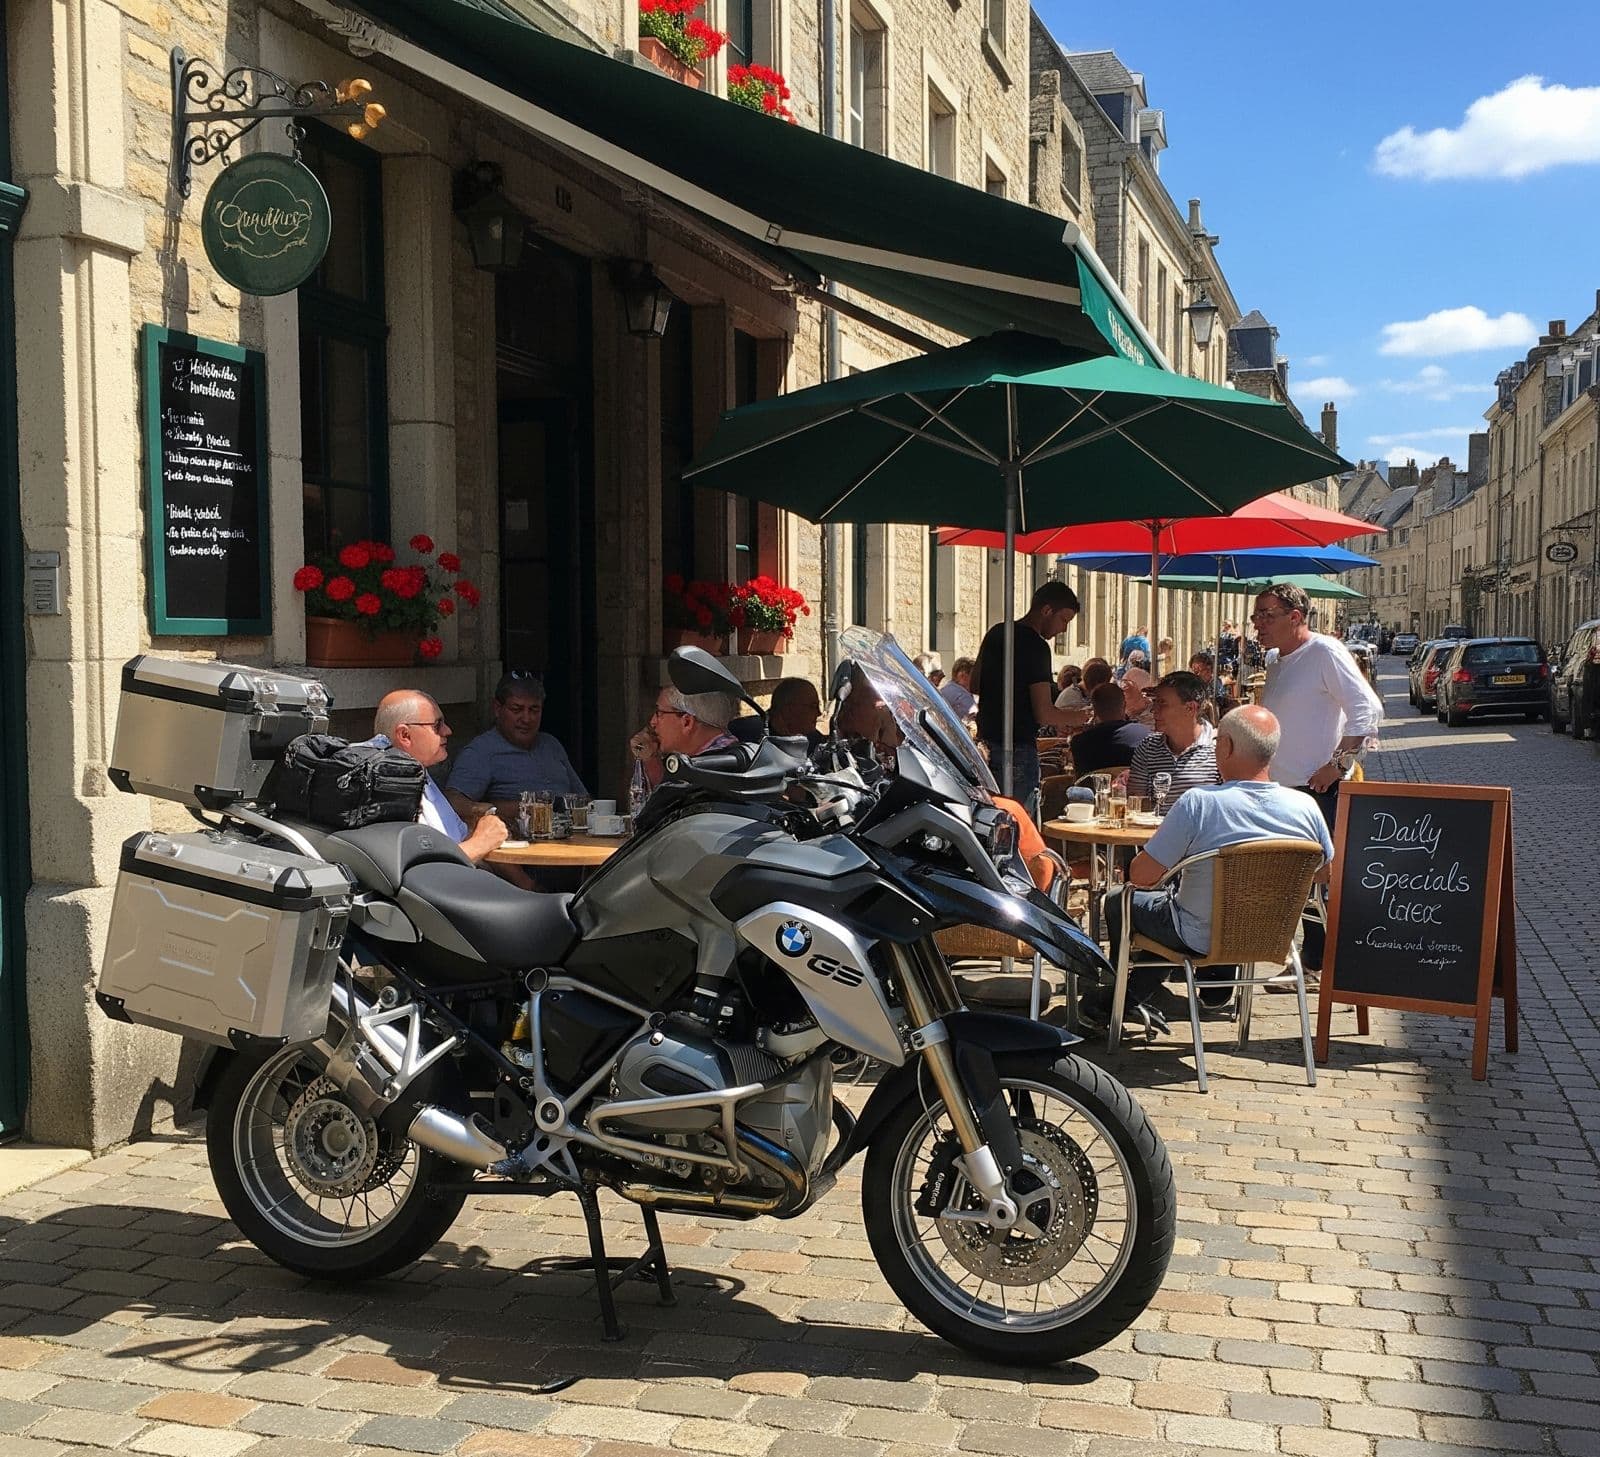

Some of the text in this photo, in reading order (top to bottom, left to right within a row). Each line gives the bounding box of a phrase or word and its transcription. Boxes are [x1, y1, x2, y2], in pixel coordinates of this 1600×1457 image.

[1370, 812, 1442, 857] Daily
[1361, 861, 1471, 905] Specials
[806, 953, 865, 988] GS
